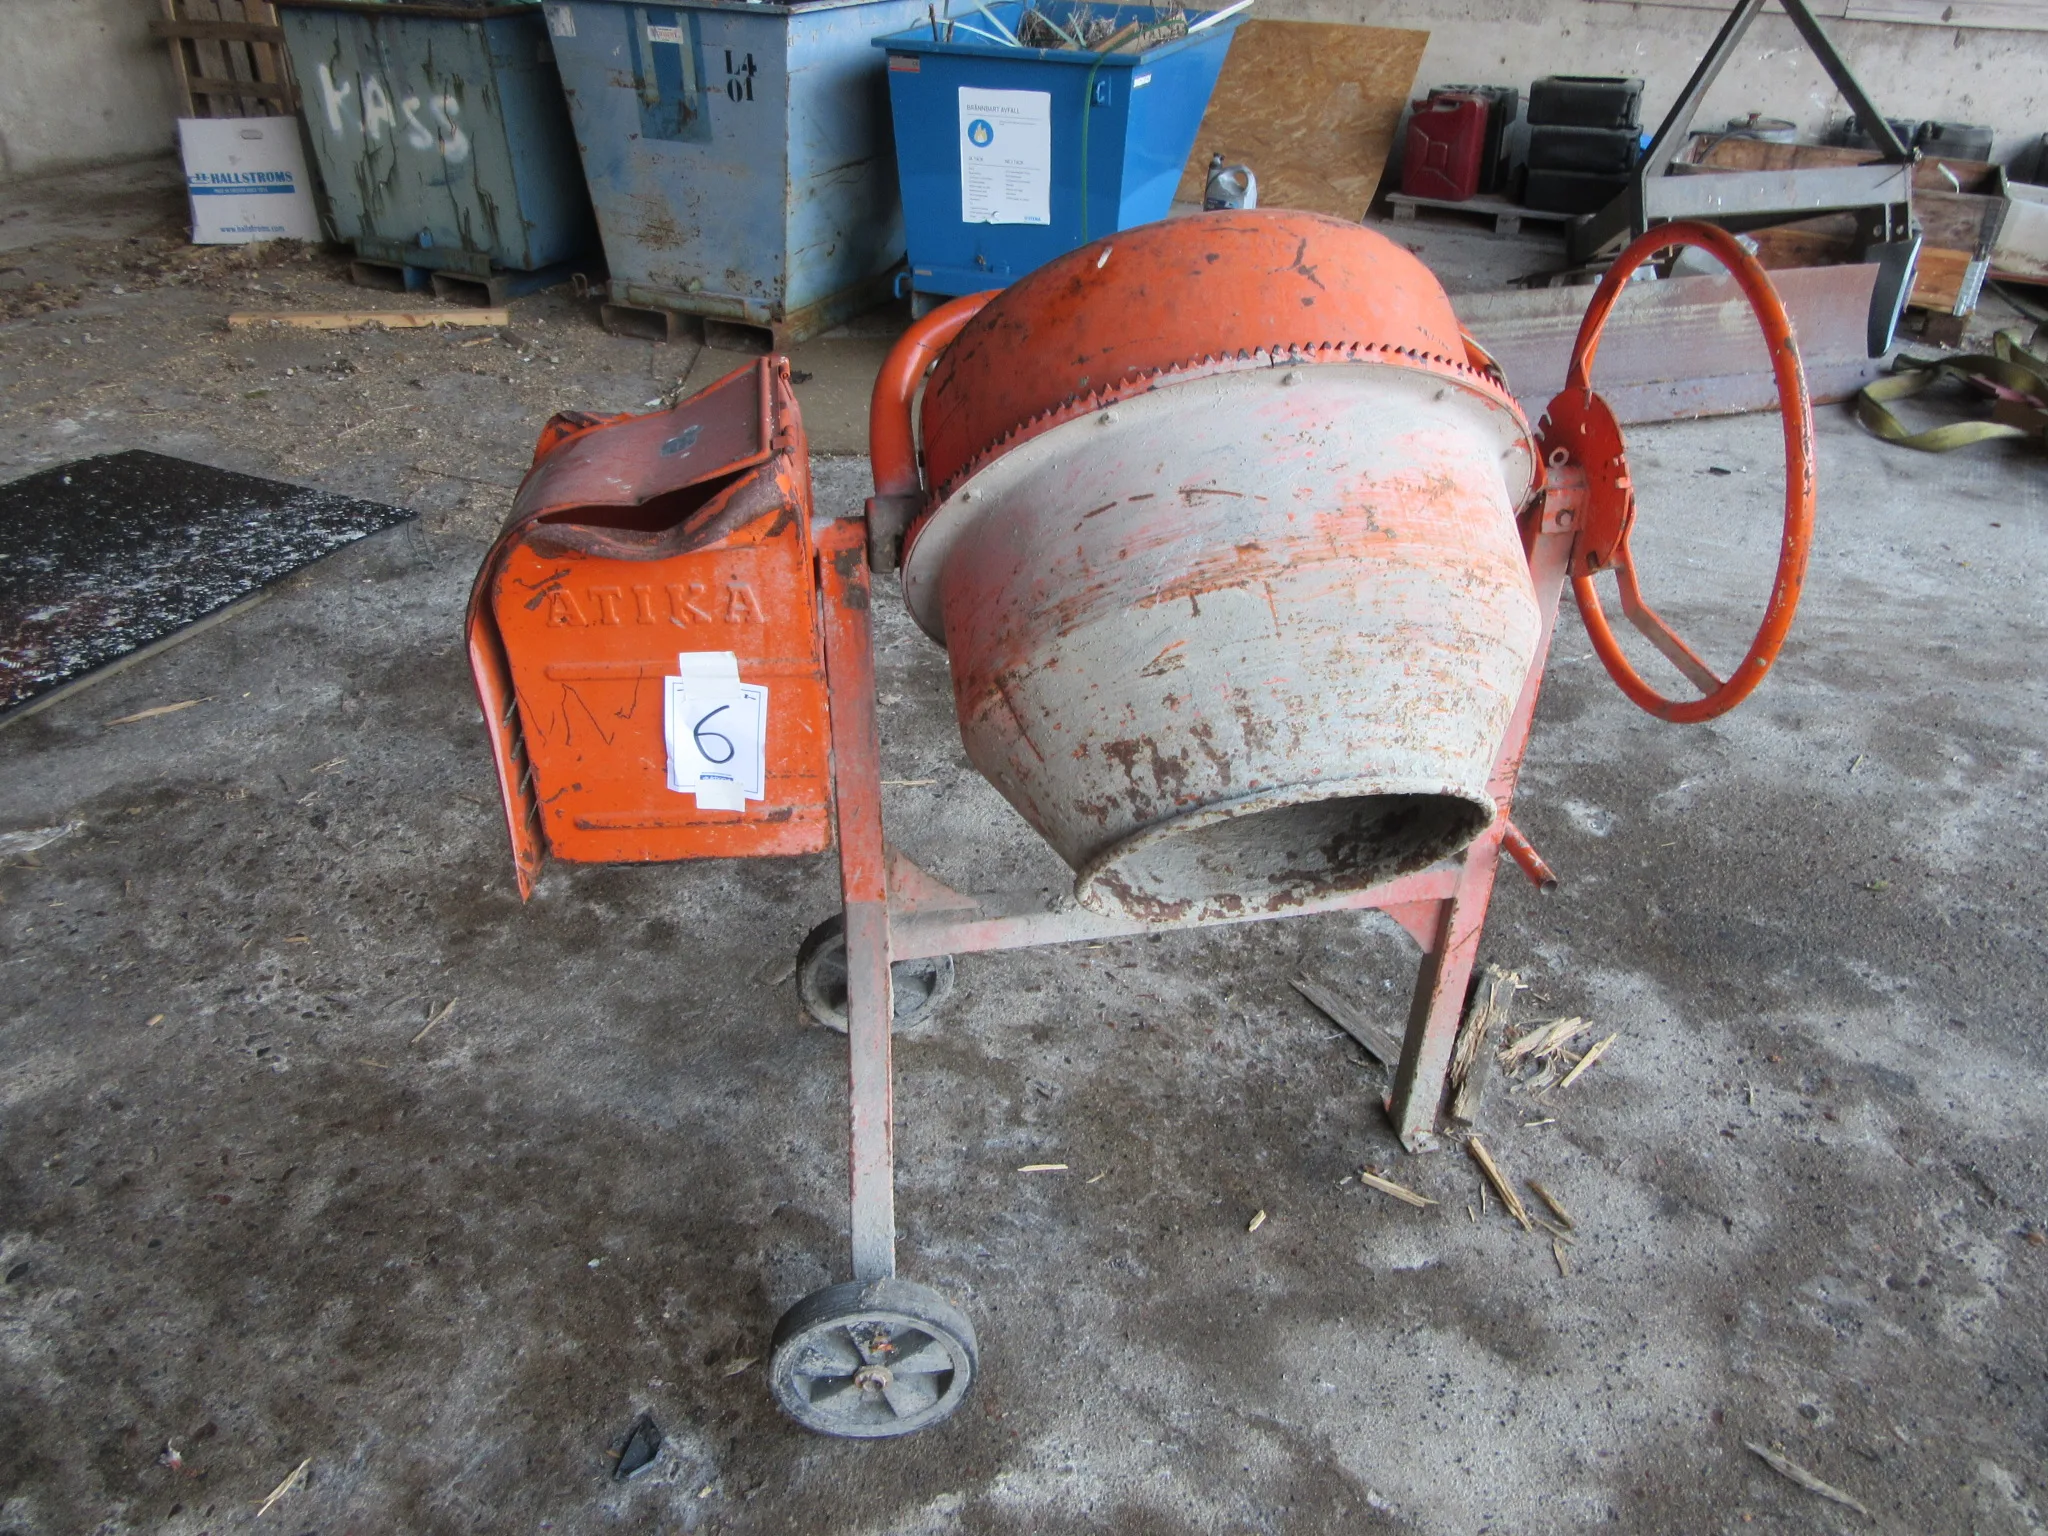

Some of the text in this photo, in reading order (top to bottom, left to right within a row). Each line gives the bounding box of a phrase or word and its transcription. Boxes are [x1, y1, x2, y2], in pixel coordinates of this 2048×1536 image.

[210, 171, 293, 184] HALLSTROMS
[546, 582, 769, 628] ATIKA
[693, 704, 735, 765] 6
